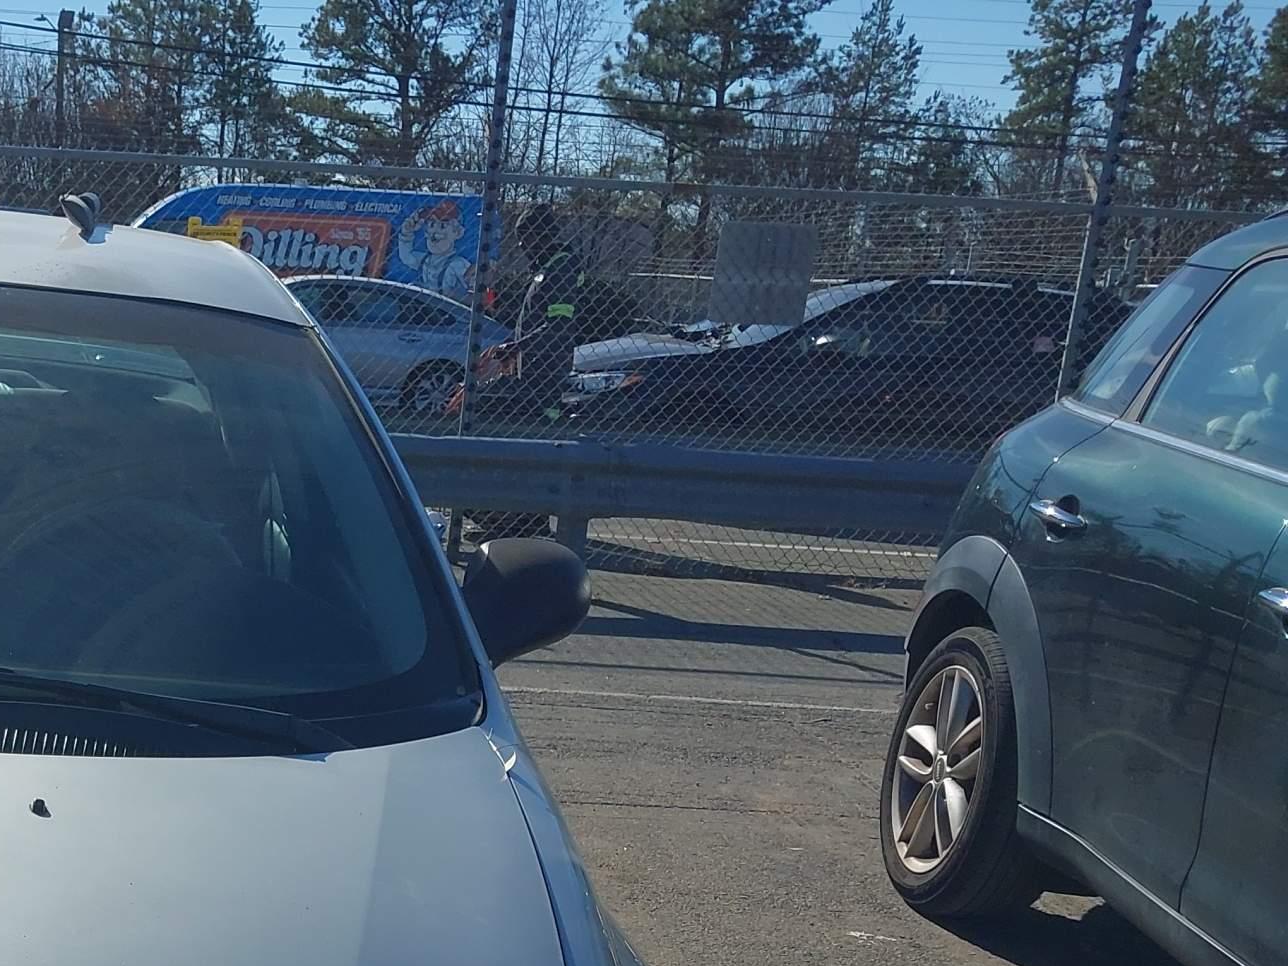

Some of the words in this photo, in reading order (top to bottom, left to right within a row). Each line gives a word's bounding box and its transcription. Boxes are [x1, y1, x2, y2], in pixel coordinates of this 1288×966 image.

[216, 194, 252, 206] HEATING
[259, 196, 296, 208] COOLING
[304, 198, 348, 210] PLUMBING
[242, 226, 369, 277] Dilling
